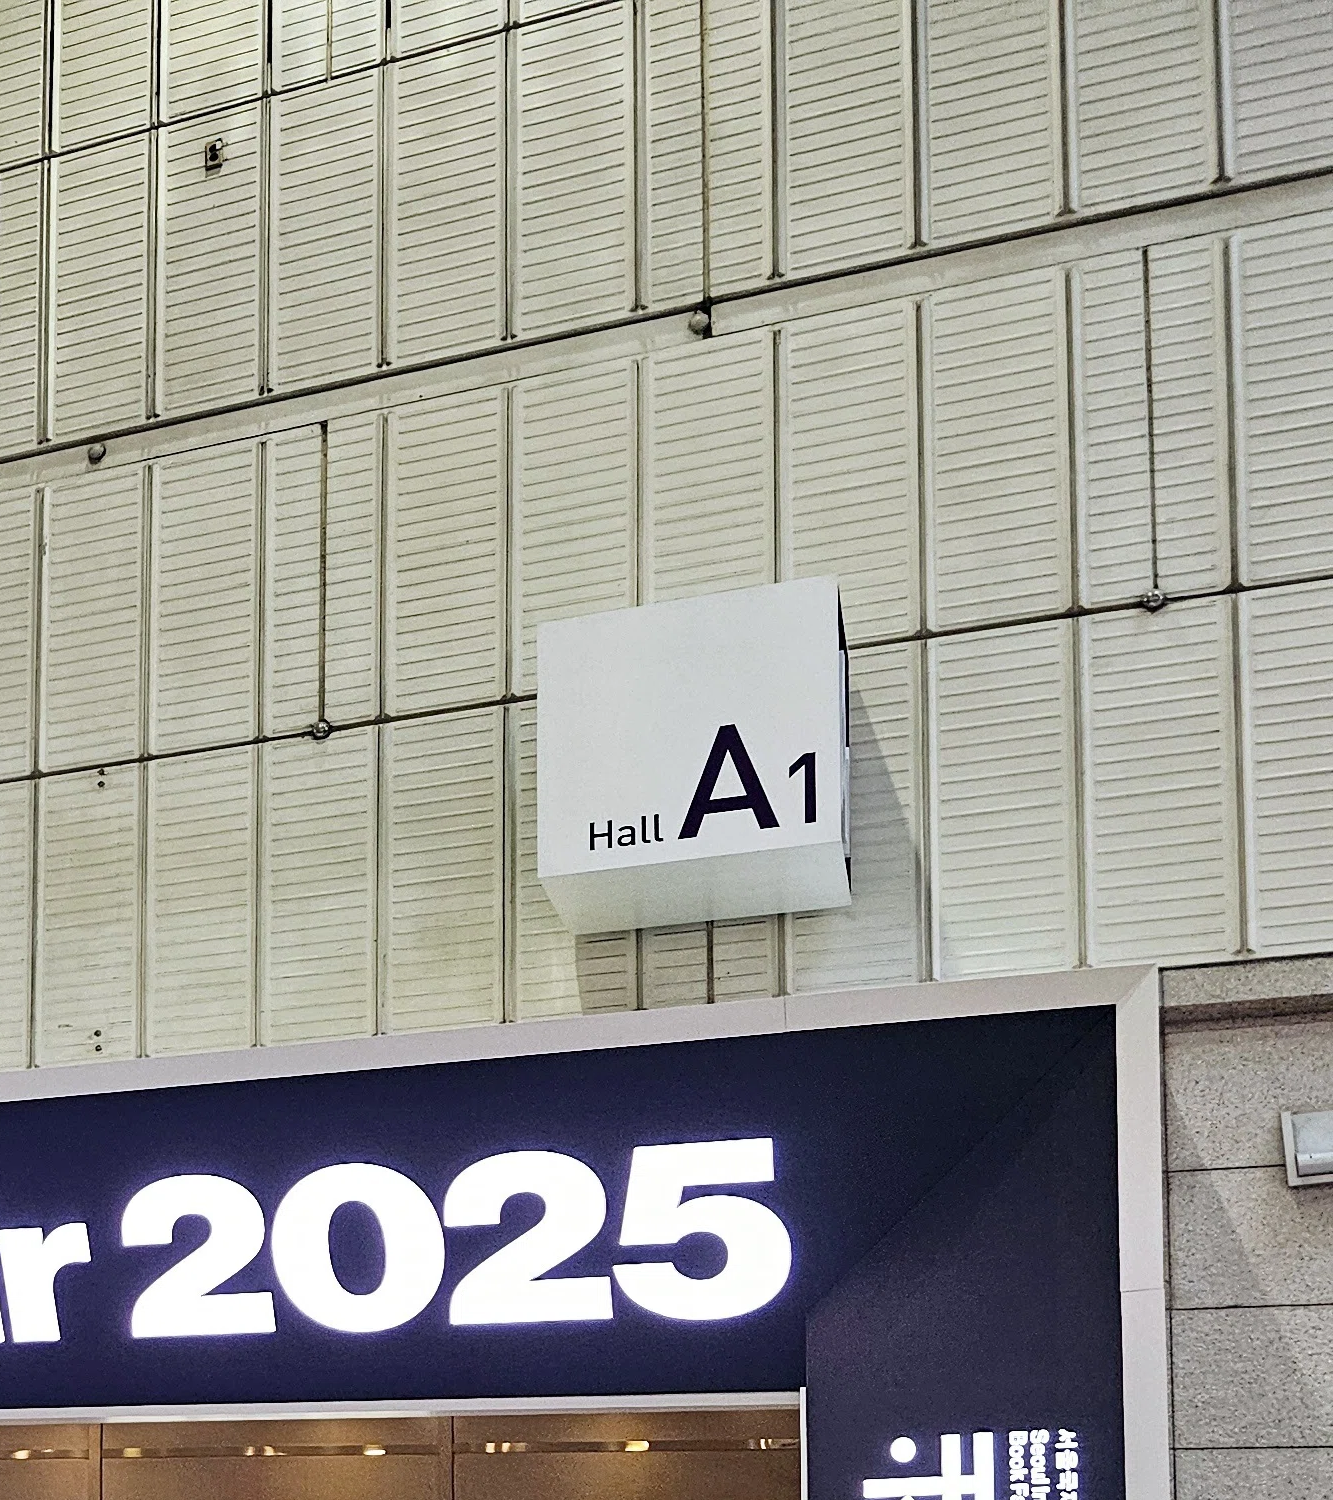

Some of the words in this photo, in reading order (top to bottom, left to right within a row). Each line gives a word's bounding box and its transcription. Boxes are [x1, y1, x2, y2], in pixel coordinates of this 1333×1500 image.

[590, 814, 664, 851] Hall
[677, 723, 817, 840] A1
[120, 1137, 792, 1338] 2025
[1008, 1430, 1029, 1483] Book
[1030, 1429, 1051, 1485] Seoul
